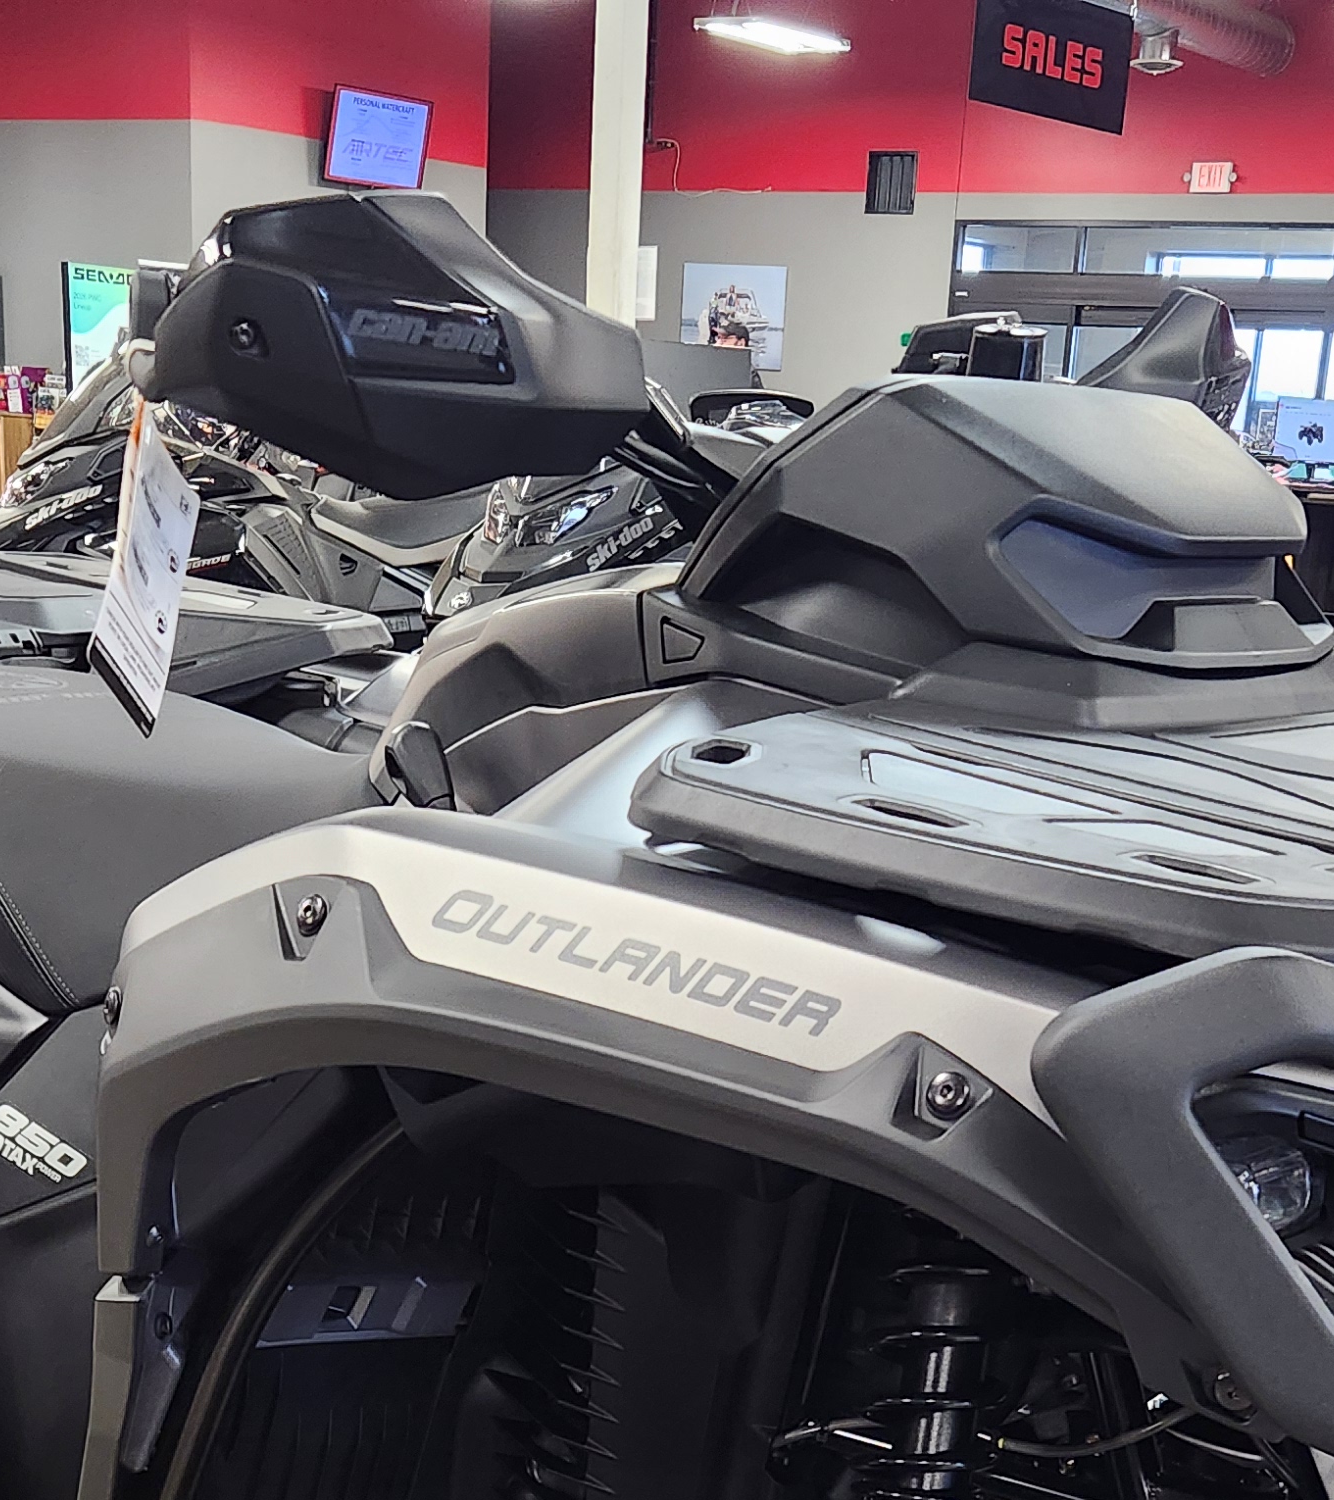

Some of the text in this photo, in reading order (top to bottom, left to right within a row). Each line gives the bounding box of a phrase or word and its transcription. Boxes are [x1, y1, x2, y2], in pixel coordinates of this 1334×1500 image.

[1002, 23, 1103, 89] SALES
[1198, 164, 1225, 188] EXIT
[25, 484, 103, 530] ski-doo
[587, 517, 654, 572] ski-doo
[431, 889, 842, 1038] OUTLANDER
[35, 1161, 62, 1183] POWER
